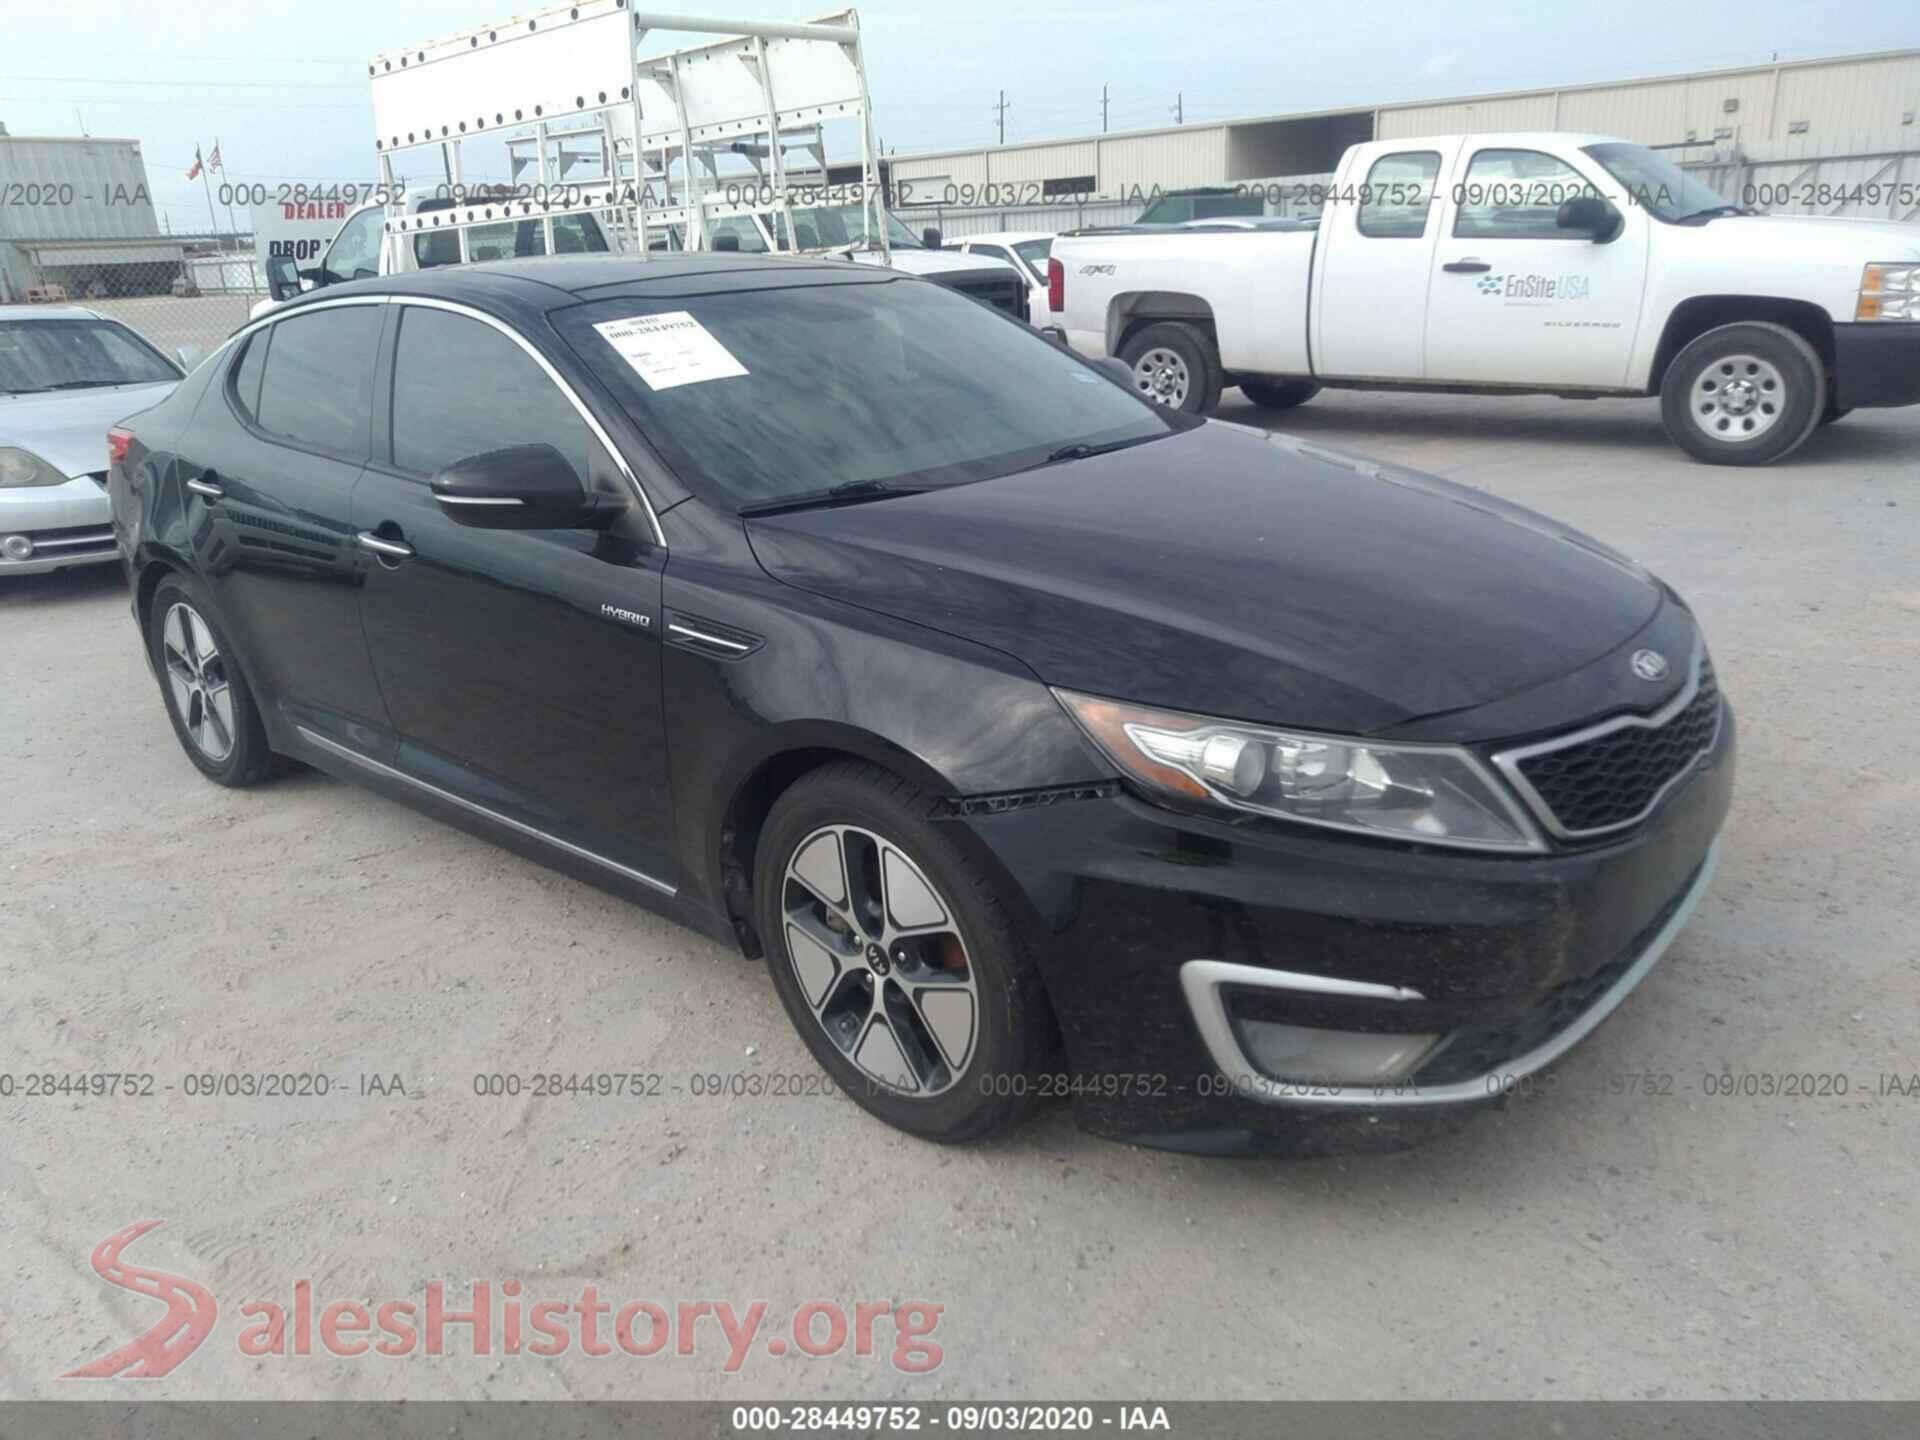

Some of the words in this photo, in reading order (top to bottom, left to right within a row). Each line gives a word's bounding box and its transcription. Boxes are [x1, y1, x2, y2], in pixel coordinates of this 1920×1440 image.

[284, 202, 345, 220] DEALER
[269, 239, 320, 260] DROP
[601, 603, 650, 627] HYBRID
